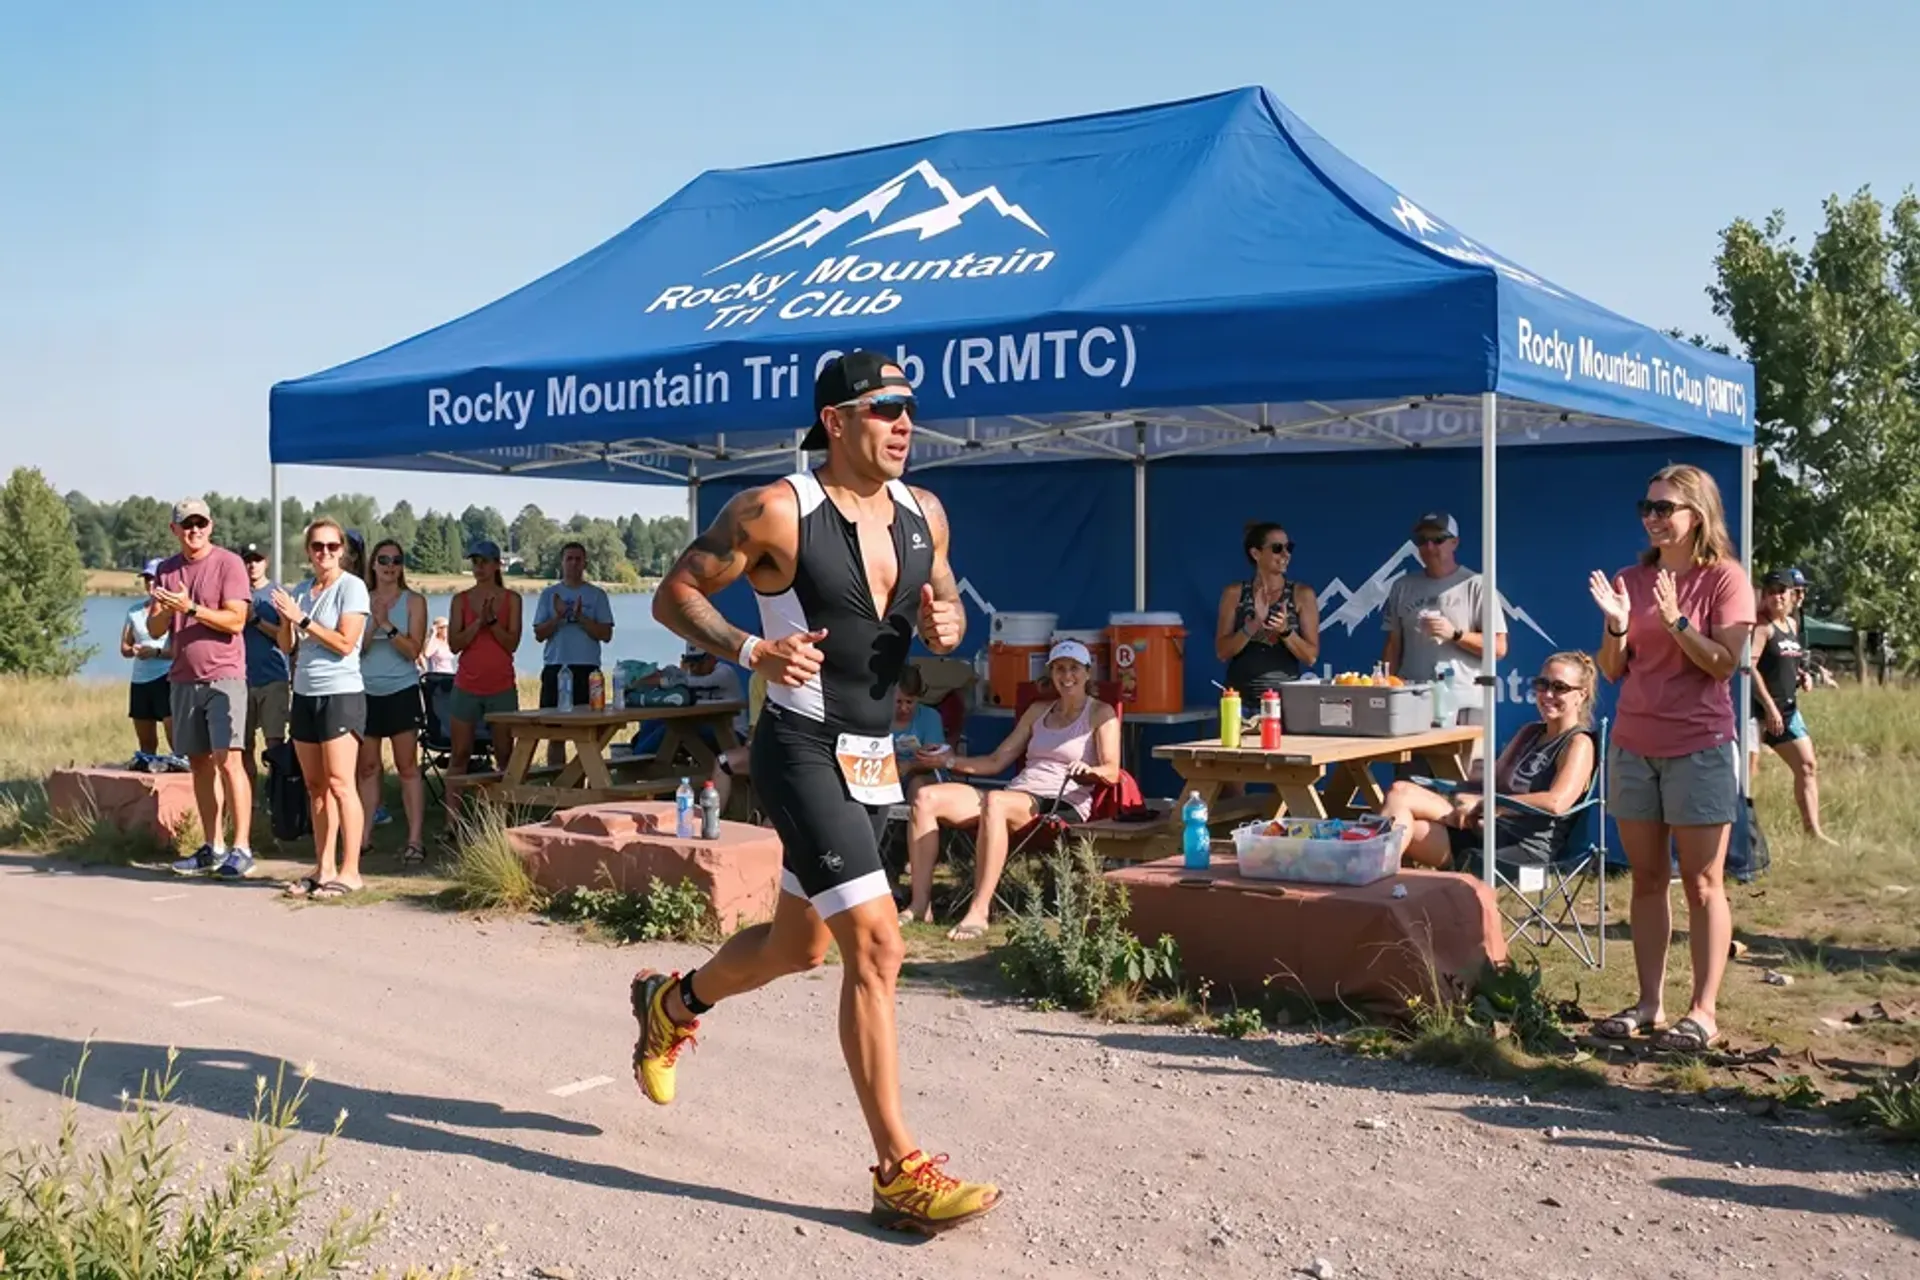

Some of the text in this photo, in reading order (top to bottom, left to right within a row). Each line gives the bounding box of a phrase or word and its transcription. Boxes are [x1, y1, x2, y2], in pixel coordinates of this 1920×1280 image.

[644, 248, 1055, 313] Rocky Mountain
[706, 288, 903, 330] Tri Club
[428, 382, 535, 430] Rocky
[547, 363, 728, 416] Mountain
[744, 354, 798, 400] Tri
[942, 325, 1136, 398] (RMTC)
[1518, 317, 1574, 381] Rocky
[1579, 336, 1650, 391] Mountain
[1651, 357, 1671, 397] Tri
[1705, 374, 1746, 428] (RMTC)
[1119, 648, 1131, 662] R
[853, 759, 882, 786] 132
